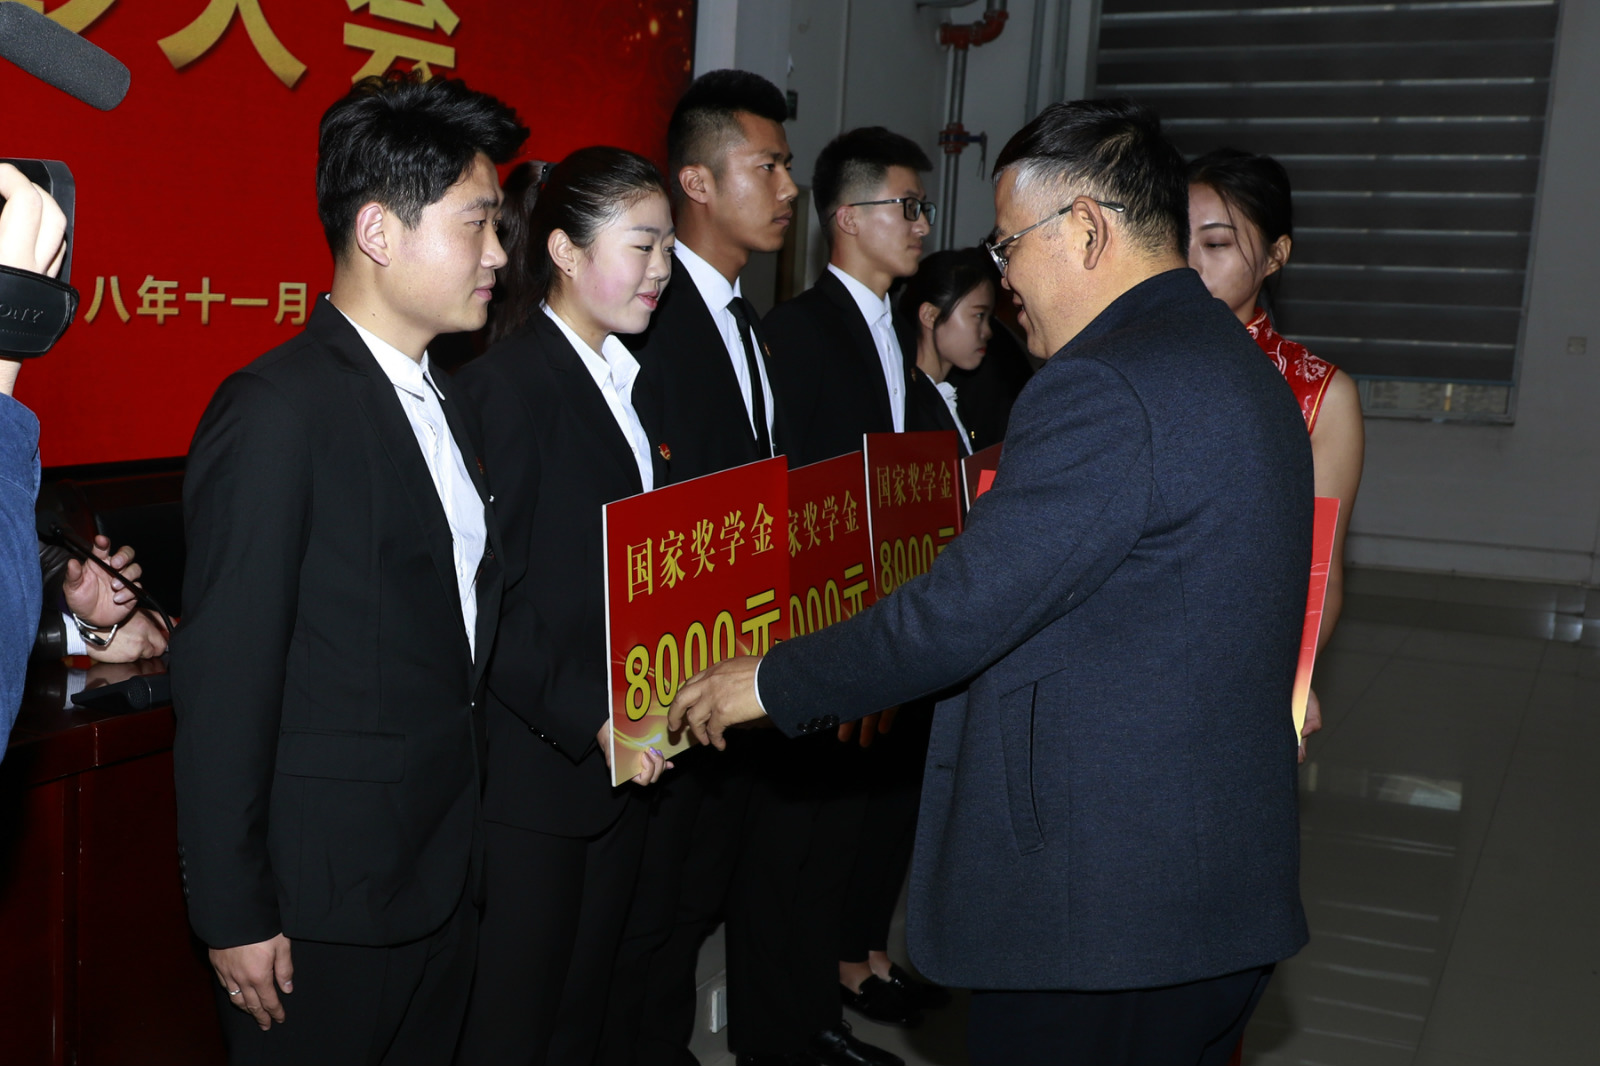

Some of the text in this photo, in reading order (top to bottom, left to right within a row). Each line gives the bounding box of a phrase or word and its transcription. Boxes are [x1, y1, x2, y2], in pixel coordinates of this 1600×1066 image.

[83, 274, 308, 326] 八年十一月
[875, 461, 953, 509] 国家奖学金
[626, 502, 775, 604] 国家奖学金
[787, 490, 859, 558] 家奖学金
[789, 562, 869, 640] 000元
[625, 588, 782, 722] 8000元
